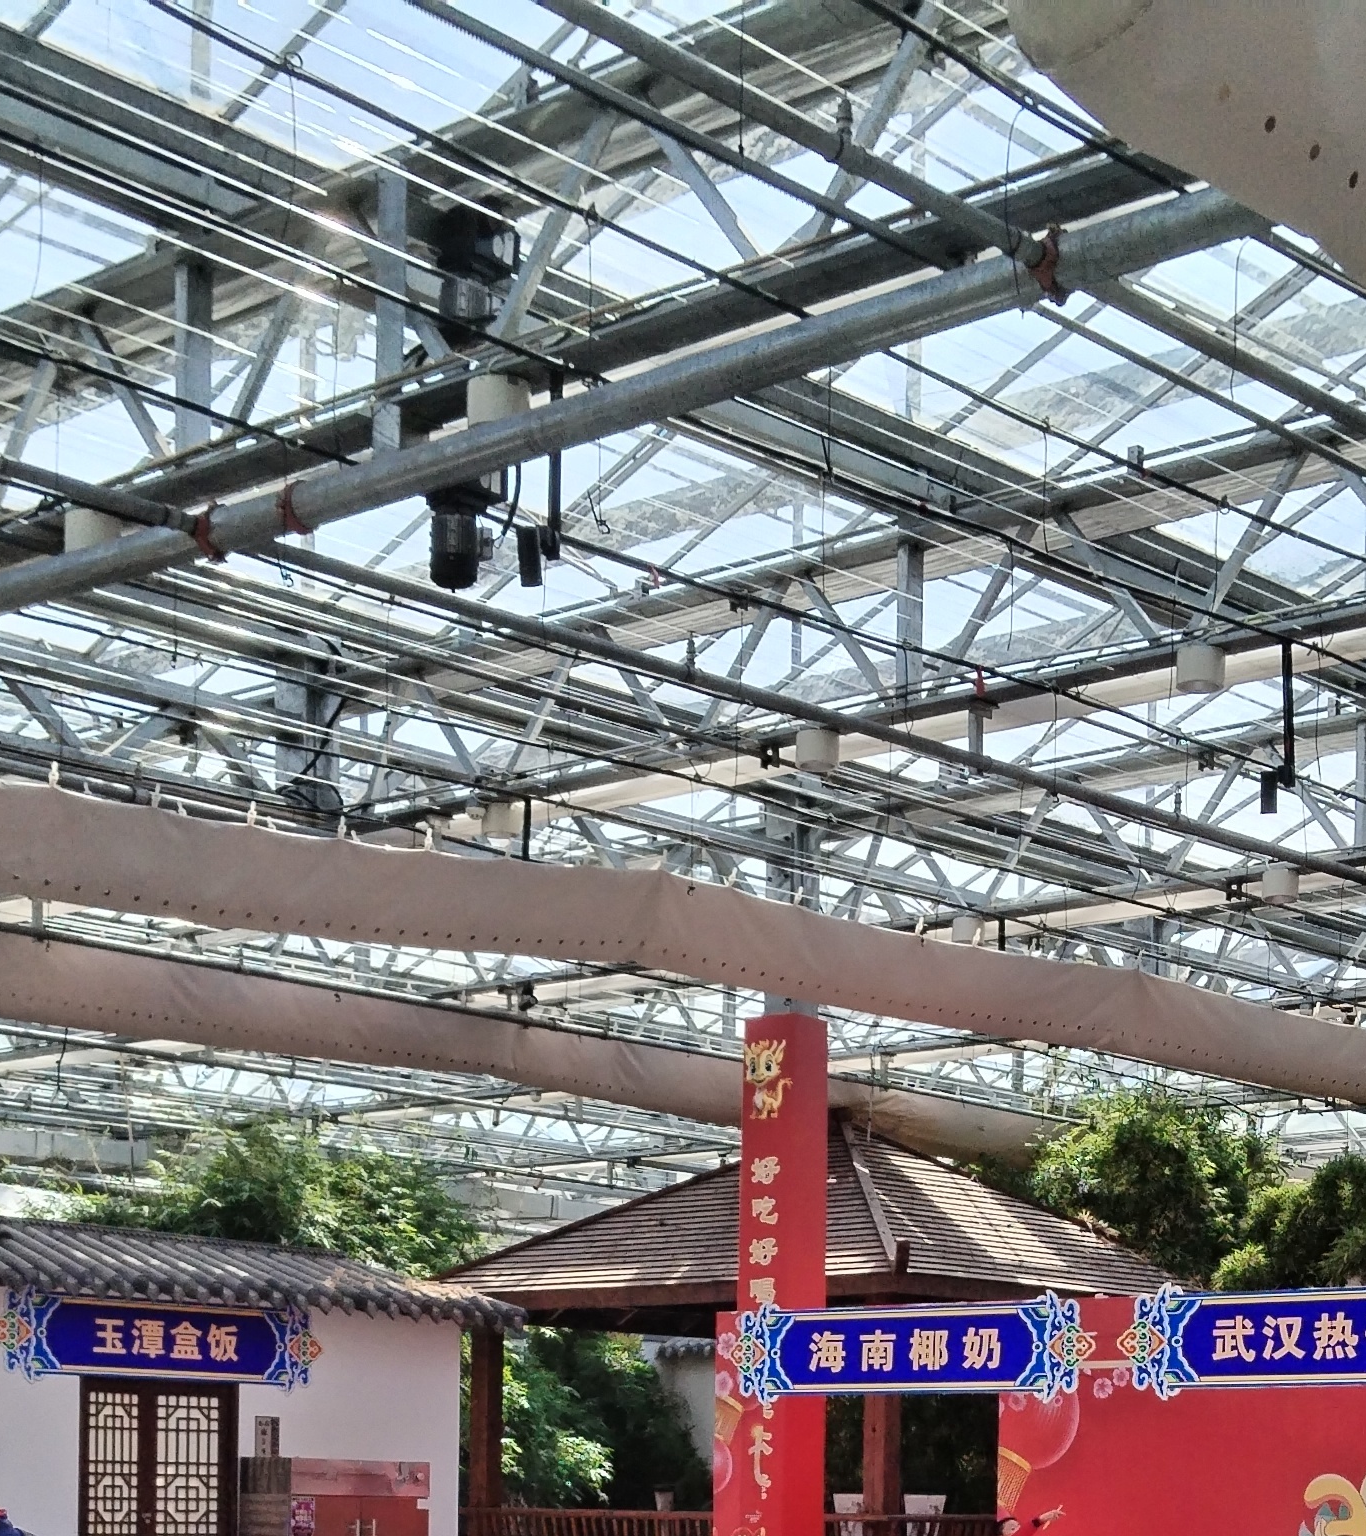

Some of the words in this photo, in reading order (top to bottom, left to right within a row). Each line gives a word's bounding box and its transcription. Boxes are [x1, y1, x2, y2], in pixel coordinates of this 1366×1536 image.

[93, 1317, 240, 1362] 玉潭盒饭
[808, 1327, 1003, 1374] 海南椰奶
